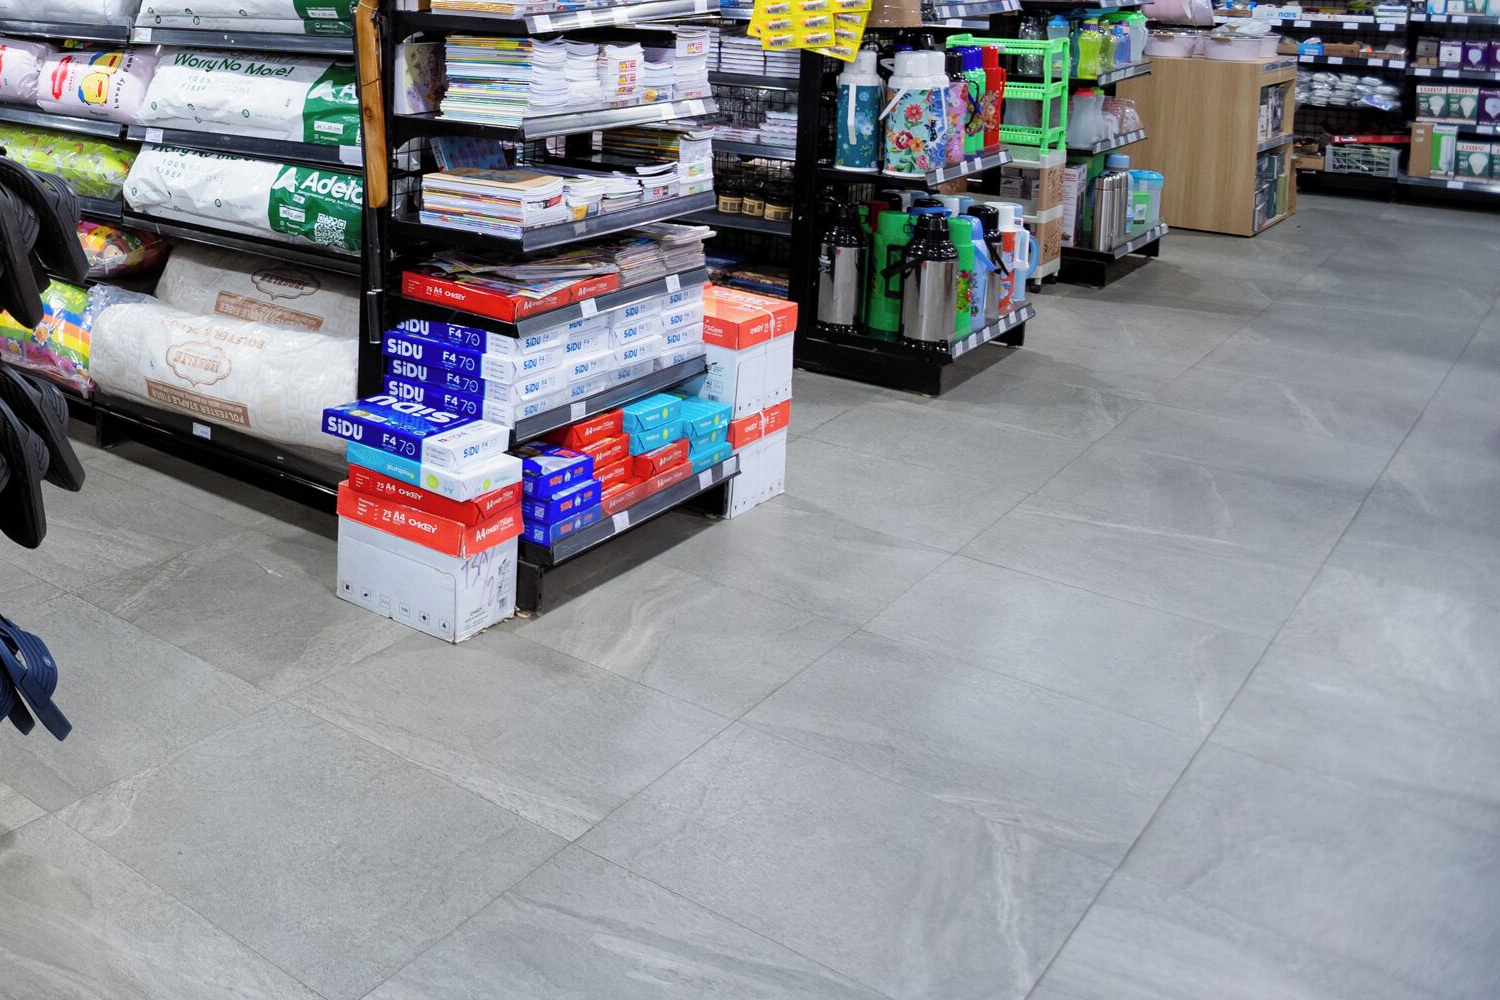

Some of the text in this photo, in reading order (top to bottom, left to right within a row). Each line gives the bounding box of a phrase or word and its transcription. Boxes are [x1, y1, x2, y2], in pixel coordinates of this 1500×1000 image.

[174, 53, 296, 78] Worry No More!
[114, 77, 126, 109] Lovely
[578, 288, 586, 296] A4
[670, 293, 682, 303] SiDU
[523, 302, 532, 310] A4
[625, 307, 638, 317] SiDU
[671, 314, 683, 324] SiDU
[449, 327, 461, 338] F4
[624, 328, 637, 338] SiDU
[526, 335, 541, 348] SiDU
[667, 333, 680, 344] SiDU
[387, 338, 422, 359] SiDU
[443, 351, 456, 362] F4
[567, 341, 582, 352] SiDU
[624, 349, 637, 359] SiDU
[524, 359, 537, 370] SiDU
[575, 363, 588, 374] SiDU
[393, 360, 428, 381] SiDU
[447, 373, 460, 384] F4
[525, 382, 539, 393] SiDU
[389, 381, 424, 402] SiDU
[445, 395, 458, 406] F4
[200, 403, 244, 424] POLYESTER
[365, 395, 459, 423] SiDU
[525, 403, 538, 415] SiDU
[328, 416, 362, 440] SiDU
[382, 433, 396, 446] F4
[463, 444, 479, 457] SiDU
[386, 483, 396, 492] A4
[486, 501, 493, 511] A4
[383, 509, 391, 518] 75
[394, 511, 405, 521] A4
[476, 527, 486, 541] A4
